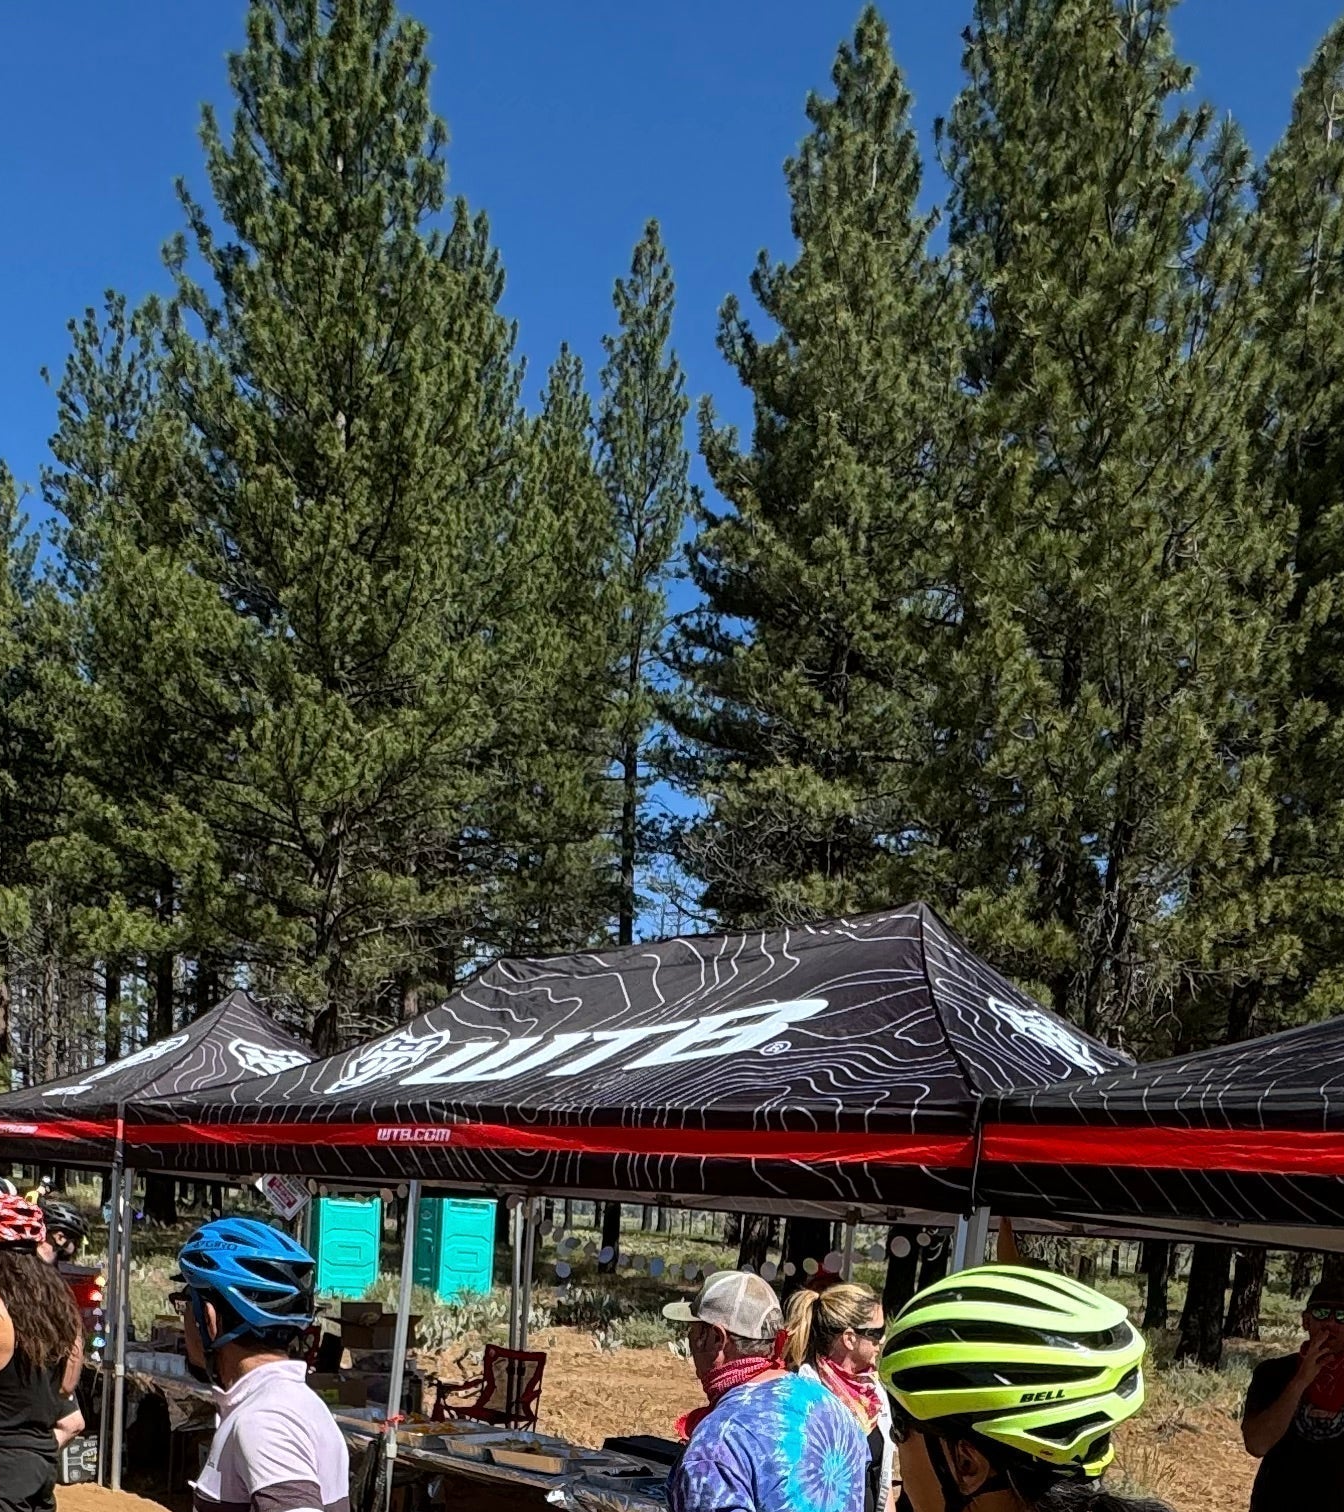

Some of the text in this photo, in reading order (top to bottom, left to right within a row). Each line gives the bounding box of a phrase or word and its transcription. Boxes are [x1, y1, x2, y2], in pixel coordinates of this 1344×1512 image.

[399, 999, 829, 1085] WTB
[377, 1128, 452, 1141] WTB.COM
[1019, 1389, 1066, 1403] BELL
